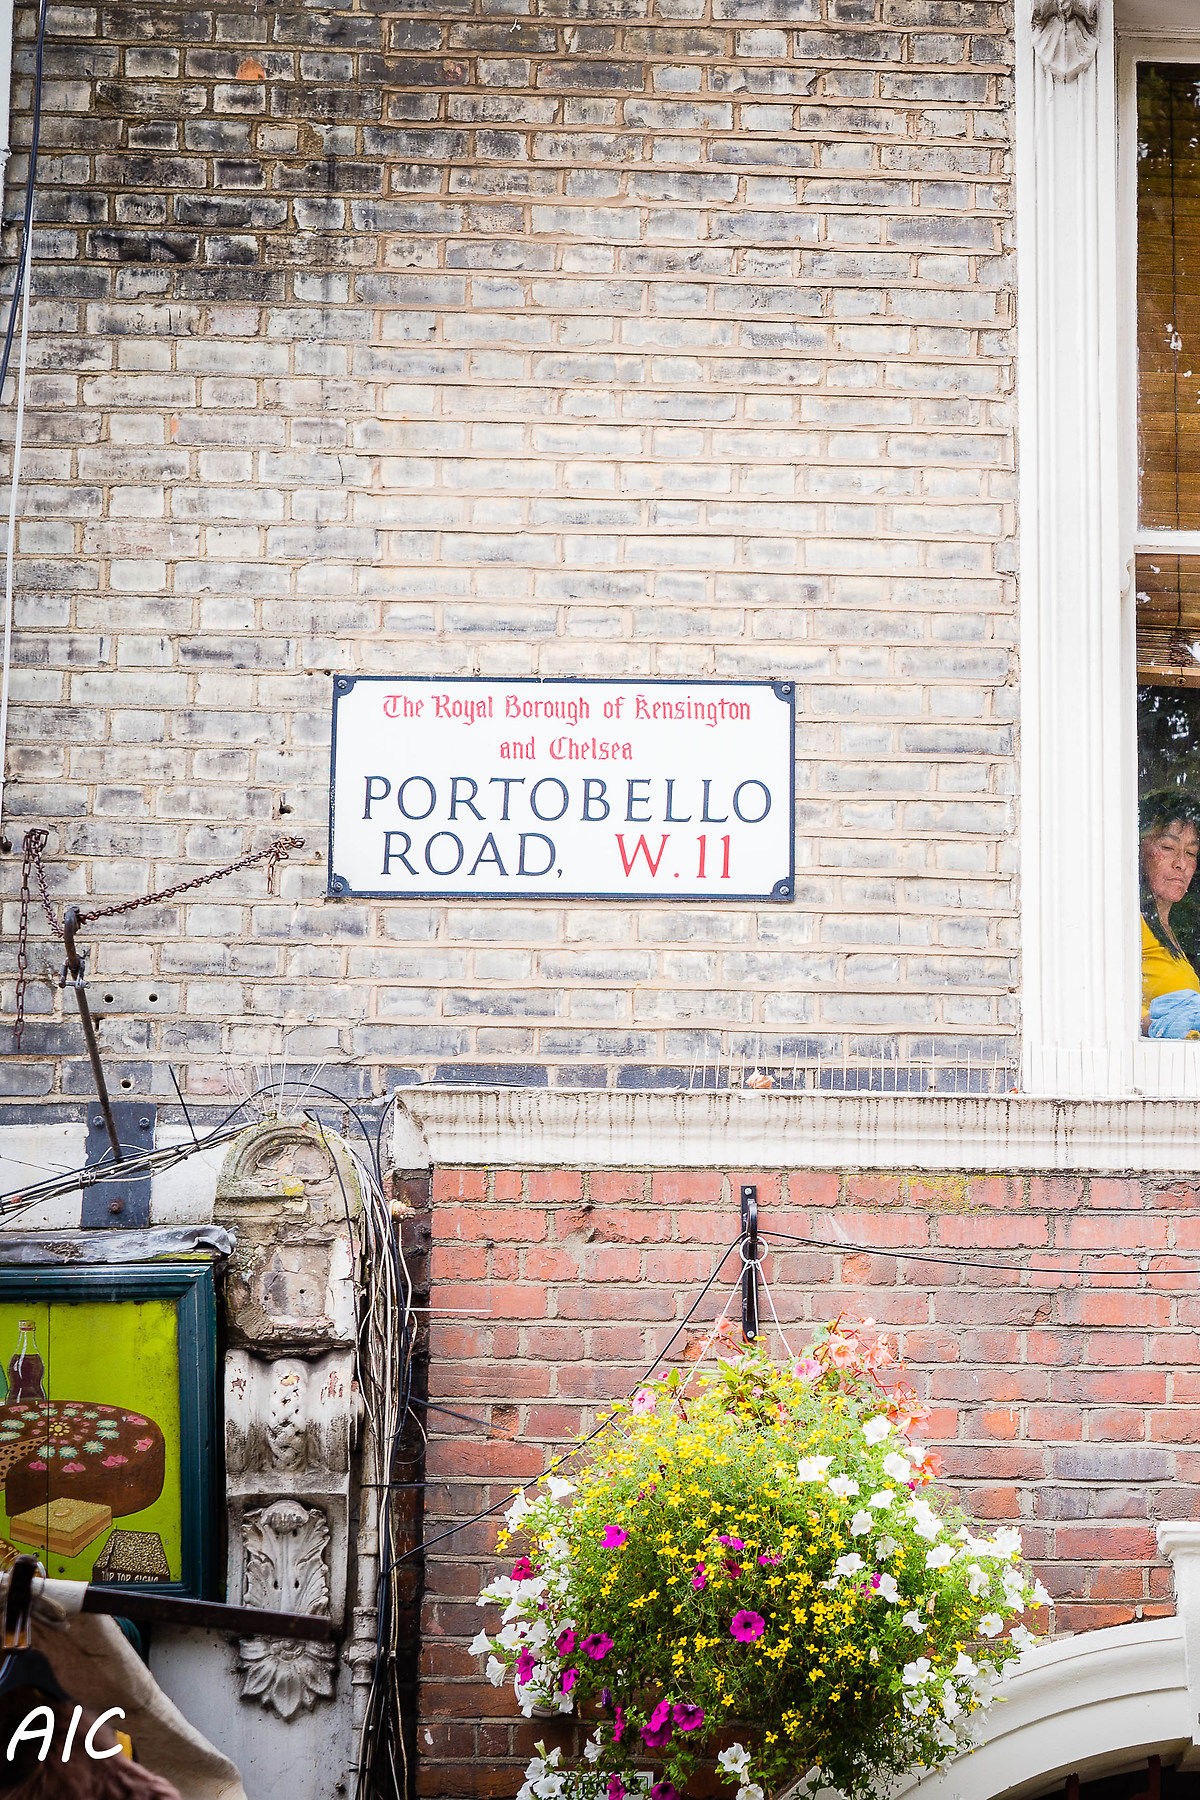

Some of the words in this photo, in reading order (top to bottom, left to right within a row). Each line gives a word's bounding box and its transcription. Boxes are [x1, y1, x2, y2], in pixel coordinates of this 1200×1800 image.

[383, 695, 424, 718] The
[431, 694, 493, 726] Royal
[505, 694, 590, 727] Borough
[604, 697, 625, 719] of
[635, 695, 751, 728] Kensington
[500, 736, 536, 760] and
[550, 737, 632, 760] Chelsea
[362, 775, 772, 824] PORTOBELLO
[380, 830, 564, 879] ROAD,
